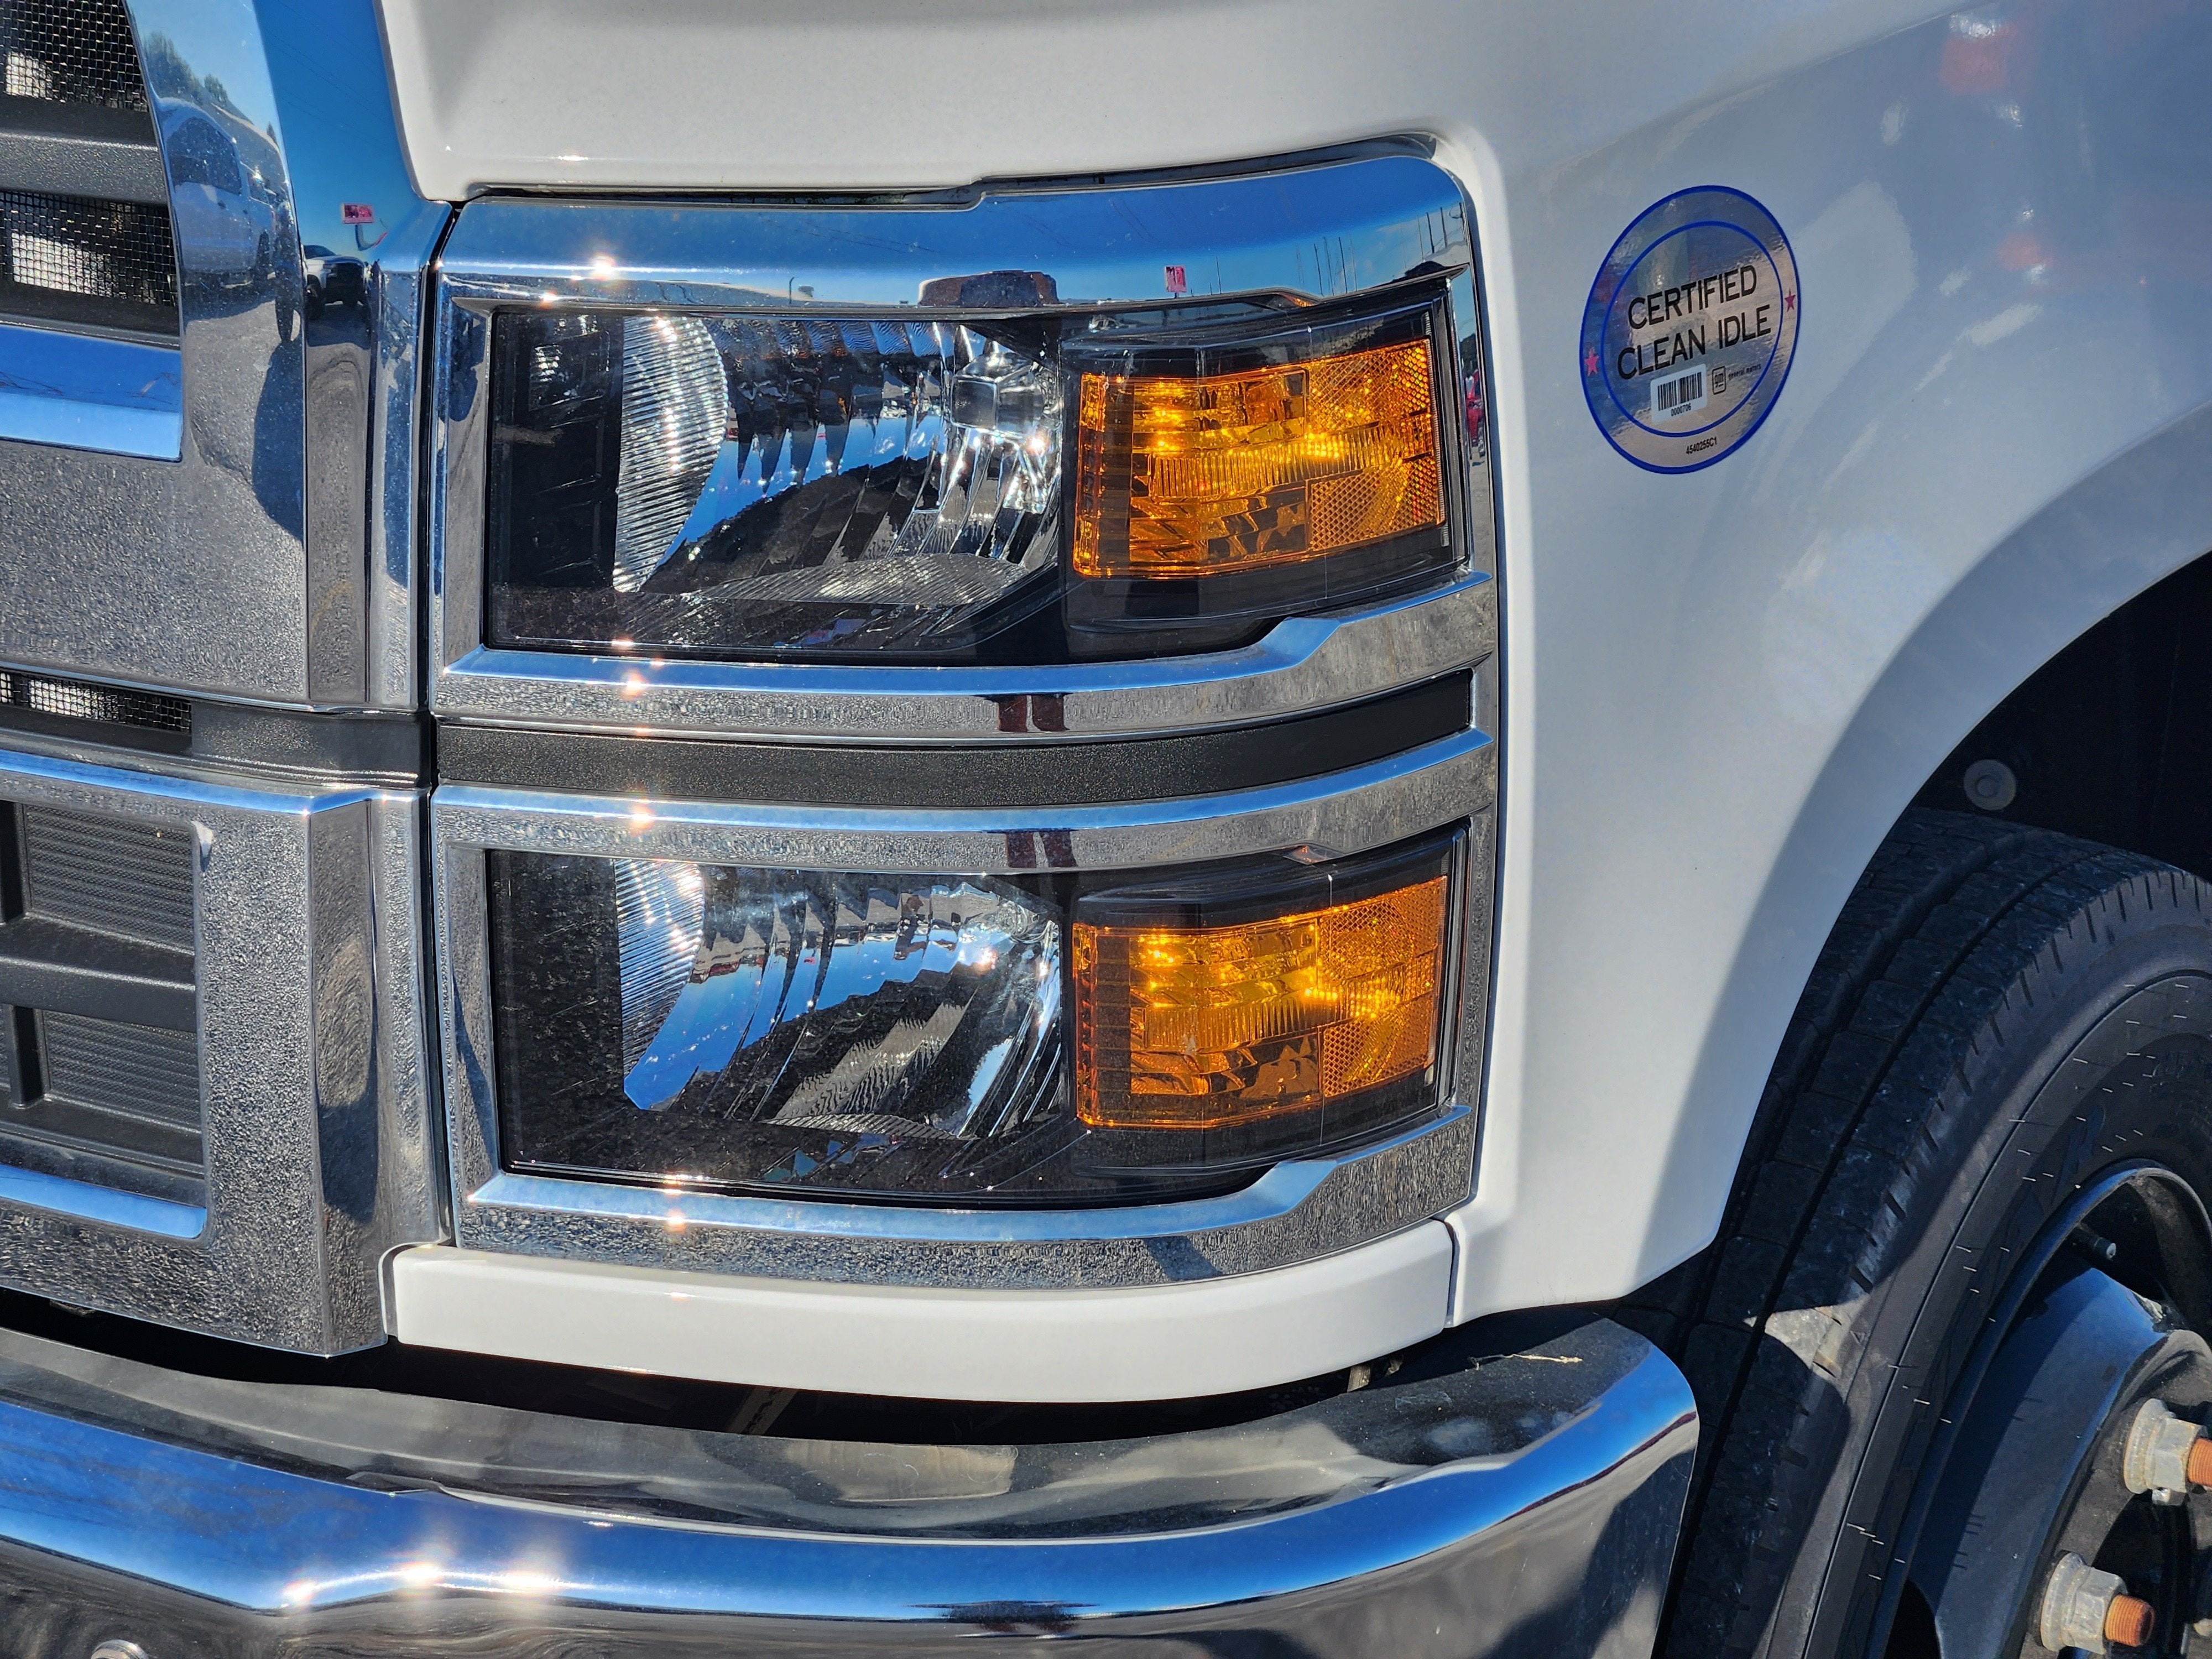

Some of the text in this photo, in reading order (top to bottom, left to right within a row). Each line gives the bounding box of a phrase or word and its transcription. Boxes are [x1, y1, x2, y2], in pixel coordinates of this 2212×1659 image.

[1628, 264, 1757, 330] CERTIFIED
[1617, 304, 1771, 380] CLEAN IDLE
